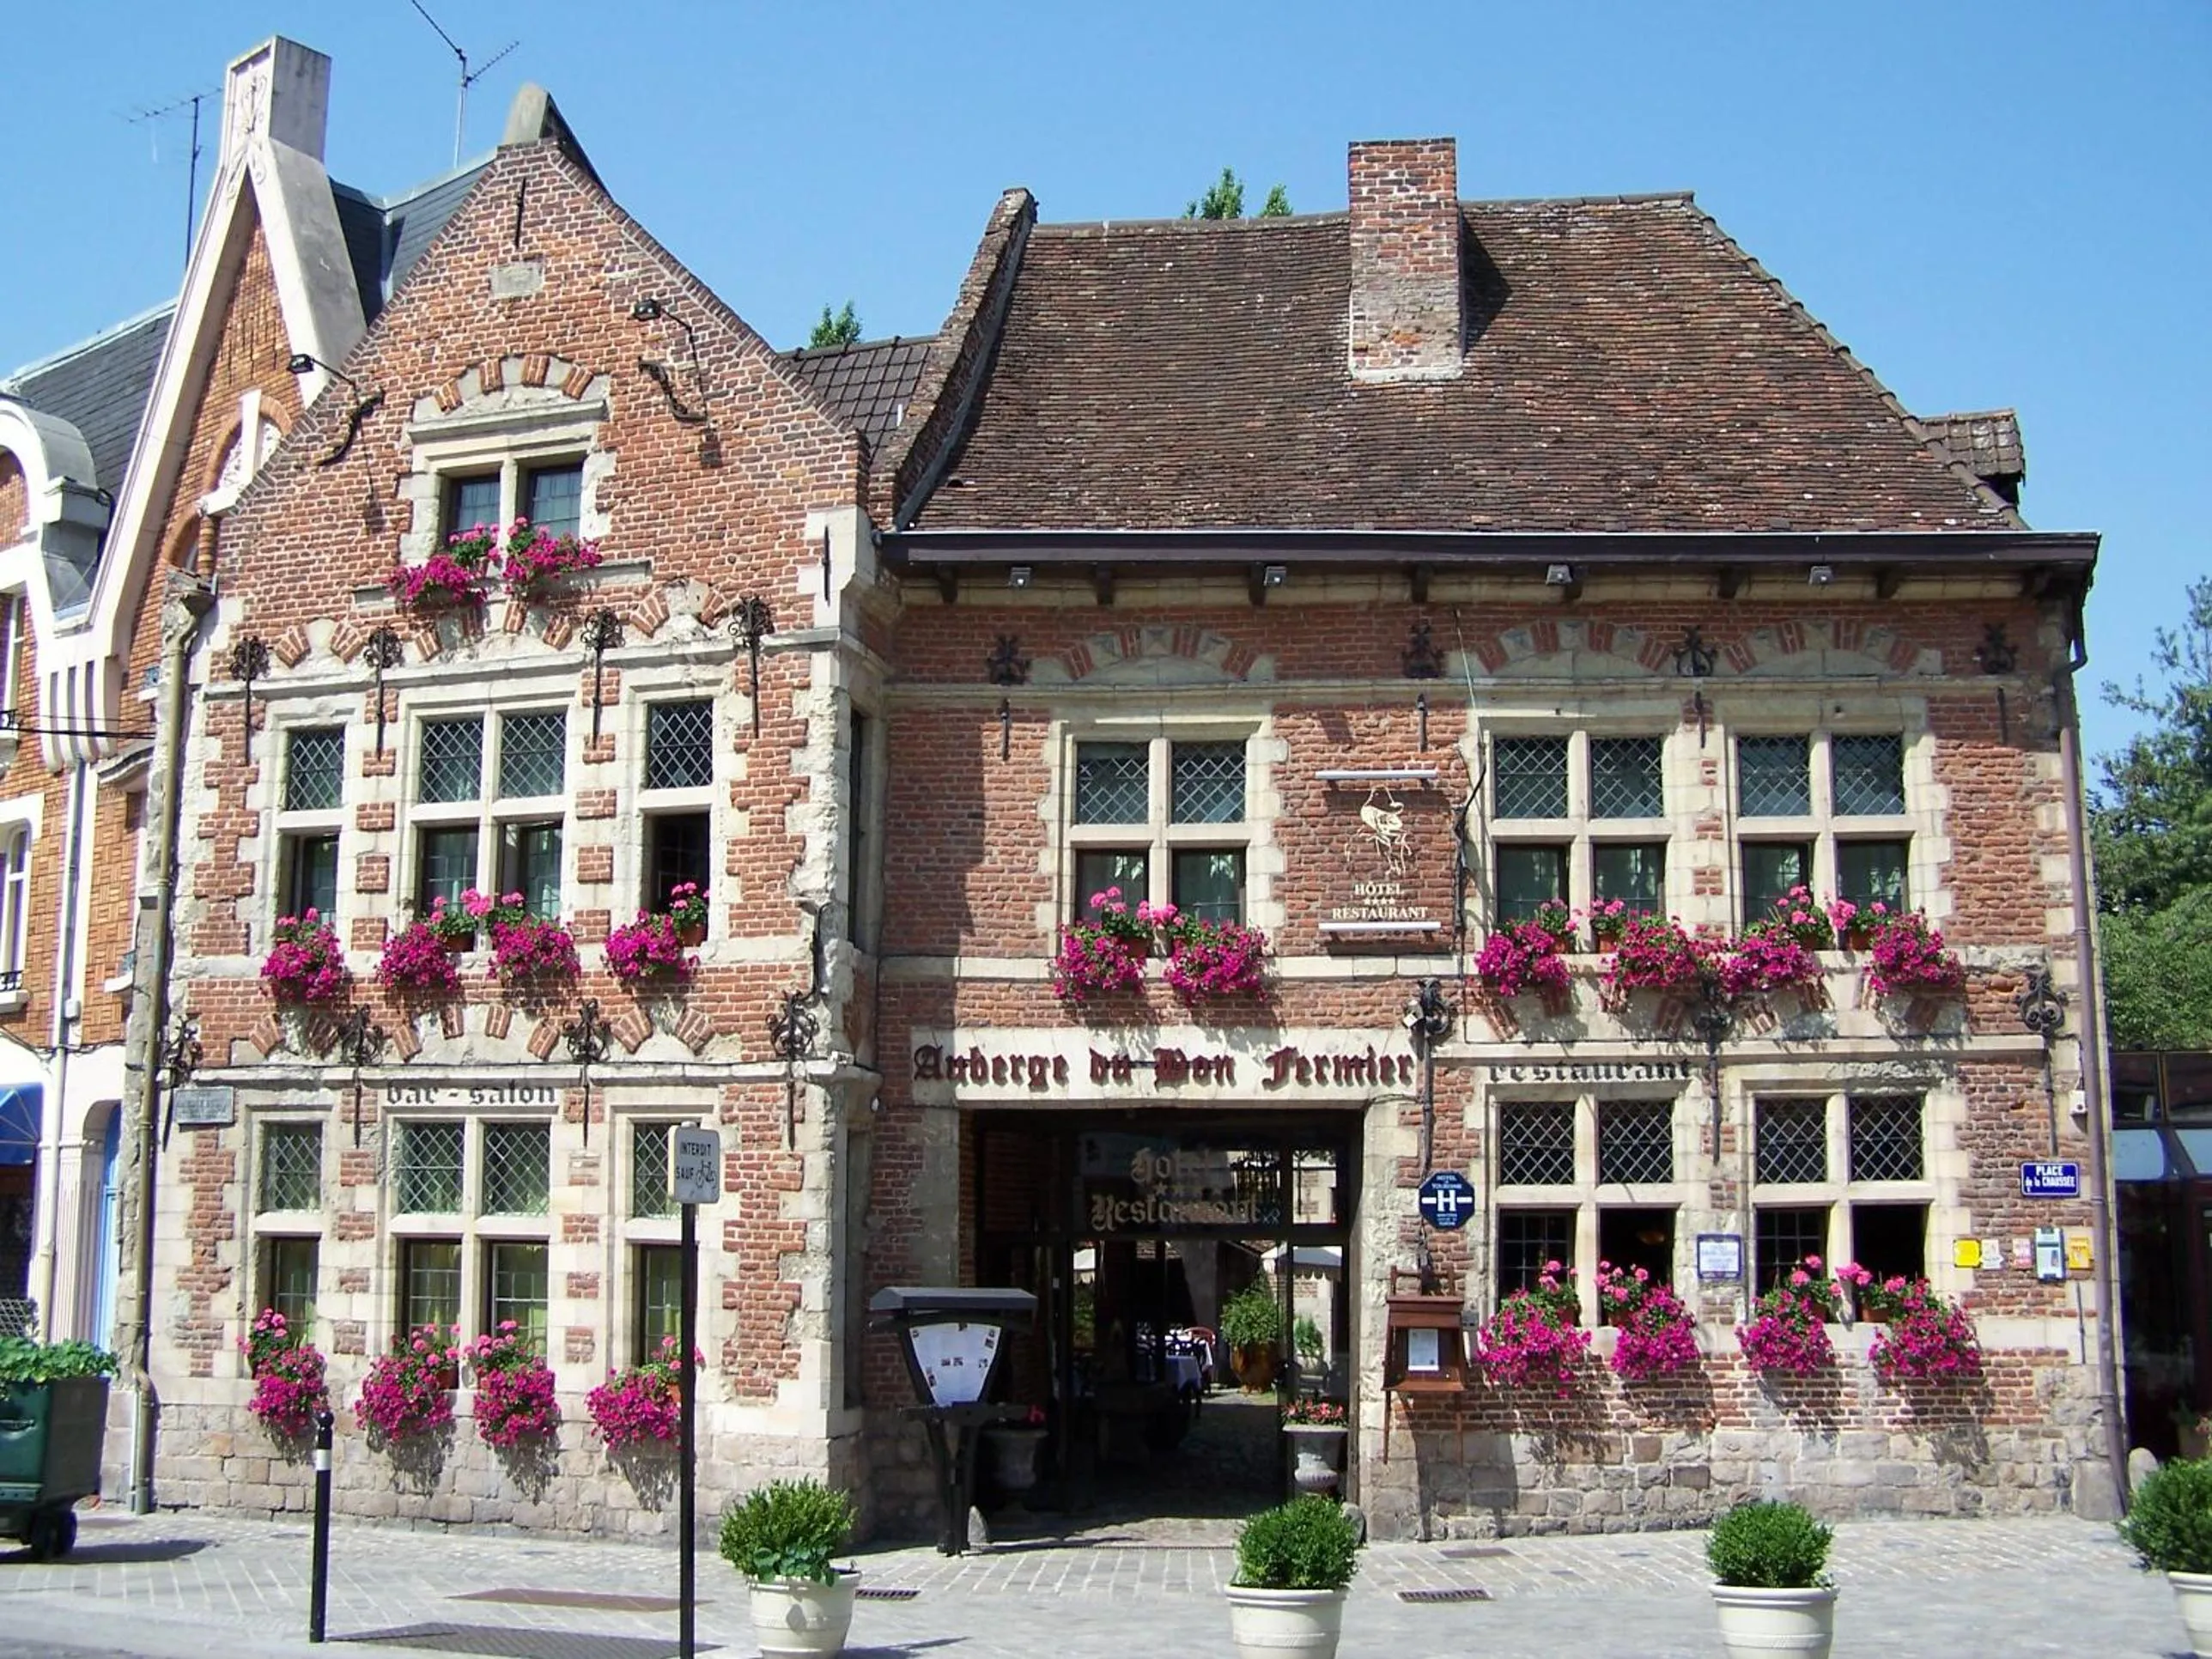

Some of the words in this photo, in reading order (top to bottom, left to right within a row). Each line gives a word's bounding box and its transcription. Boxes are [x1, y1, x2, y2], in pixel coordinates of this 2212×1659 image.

[1354, 881, 1405, 896] HÔTEL
[1332, 906, 1429, 920] RESTAURANT
[914, 1044, 1070, 1093] Auberge
[1089, 1047, 1133, 1086] du
[1153, 1047, 1237, 1091] Bon
[1262, 1043, 1415, 1091] Fermier
[1489, 1058, 1690, 1083] restaurant
[469, 1079, 557, 1105] salon
[680, 1141, 712, 1156] INTERDIT
[676, 1165, 694, 1180] SAUF
[2036, 1165, 2064, 1176] PLACE
[1437, 1189, 1456, 1212] H
